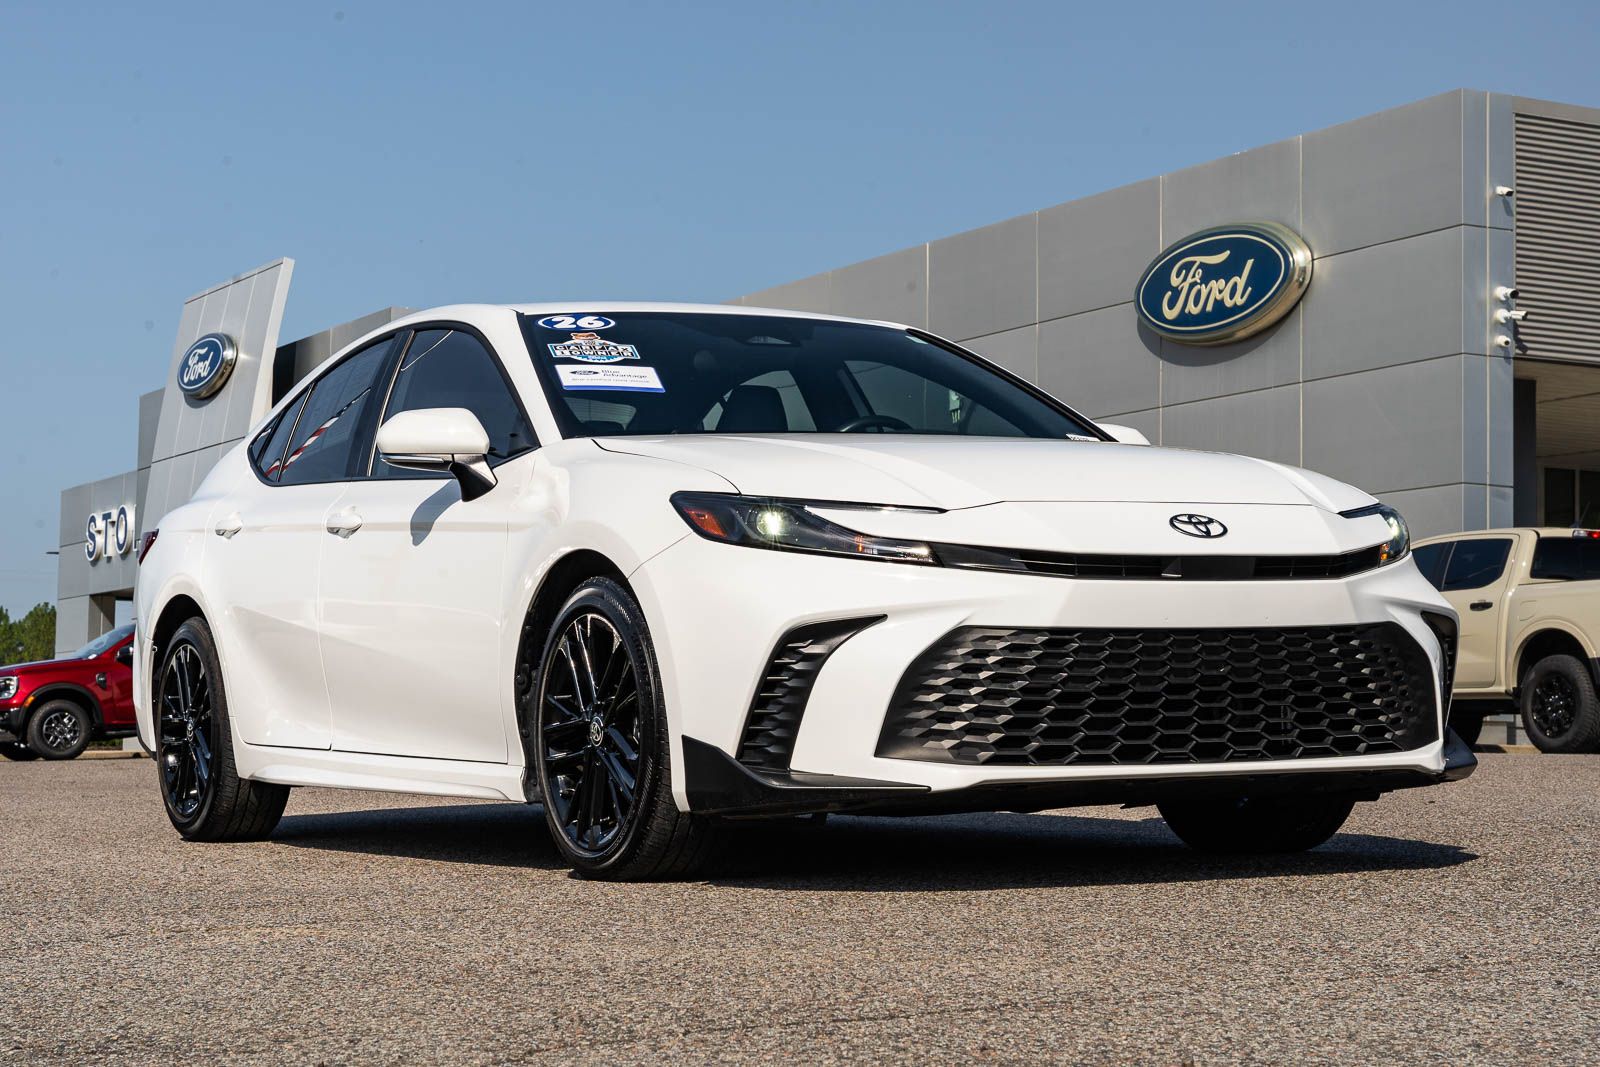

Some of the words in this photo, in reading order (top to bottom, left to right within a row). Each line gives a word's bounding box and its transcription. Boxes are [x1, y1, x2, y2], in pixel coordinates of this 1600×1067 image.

[1162, 250, 1254, 320] Ford
[551, 315, 605, 328] 26
[183, 346, 214, 384] Ford
[85, 504, 137, 561] STO
